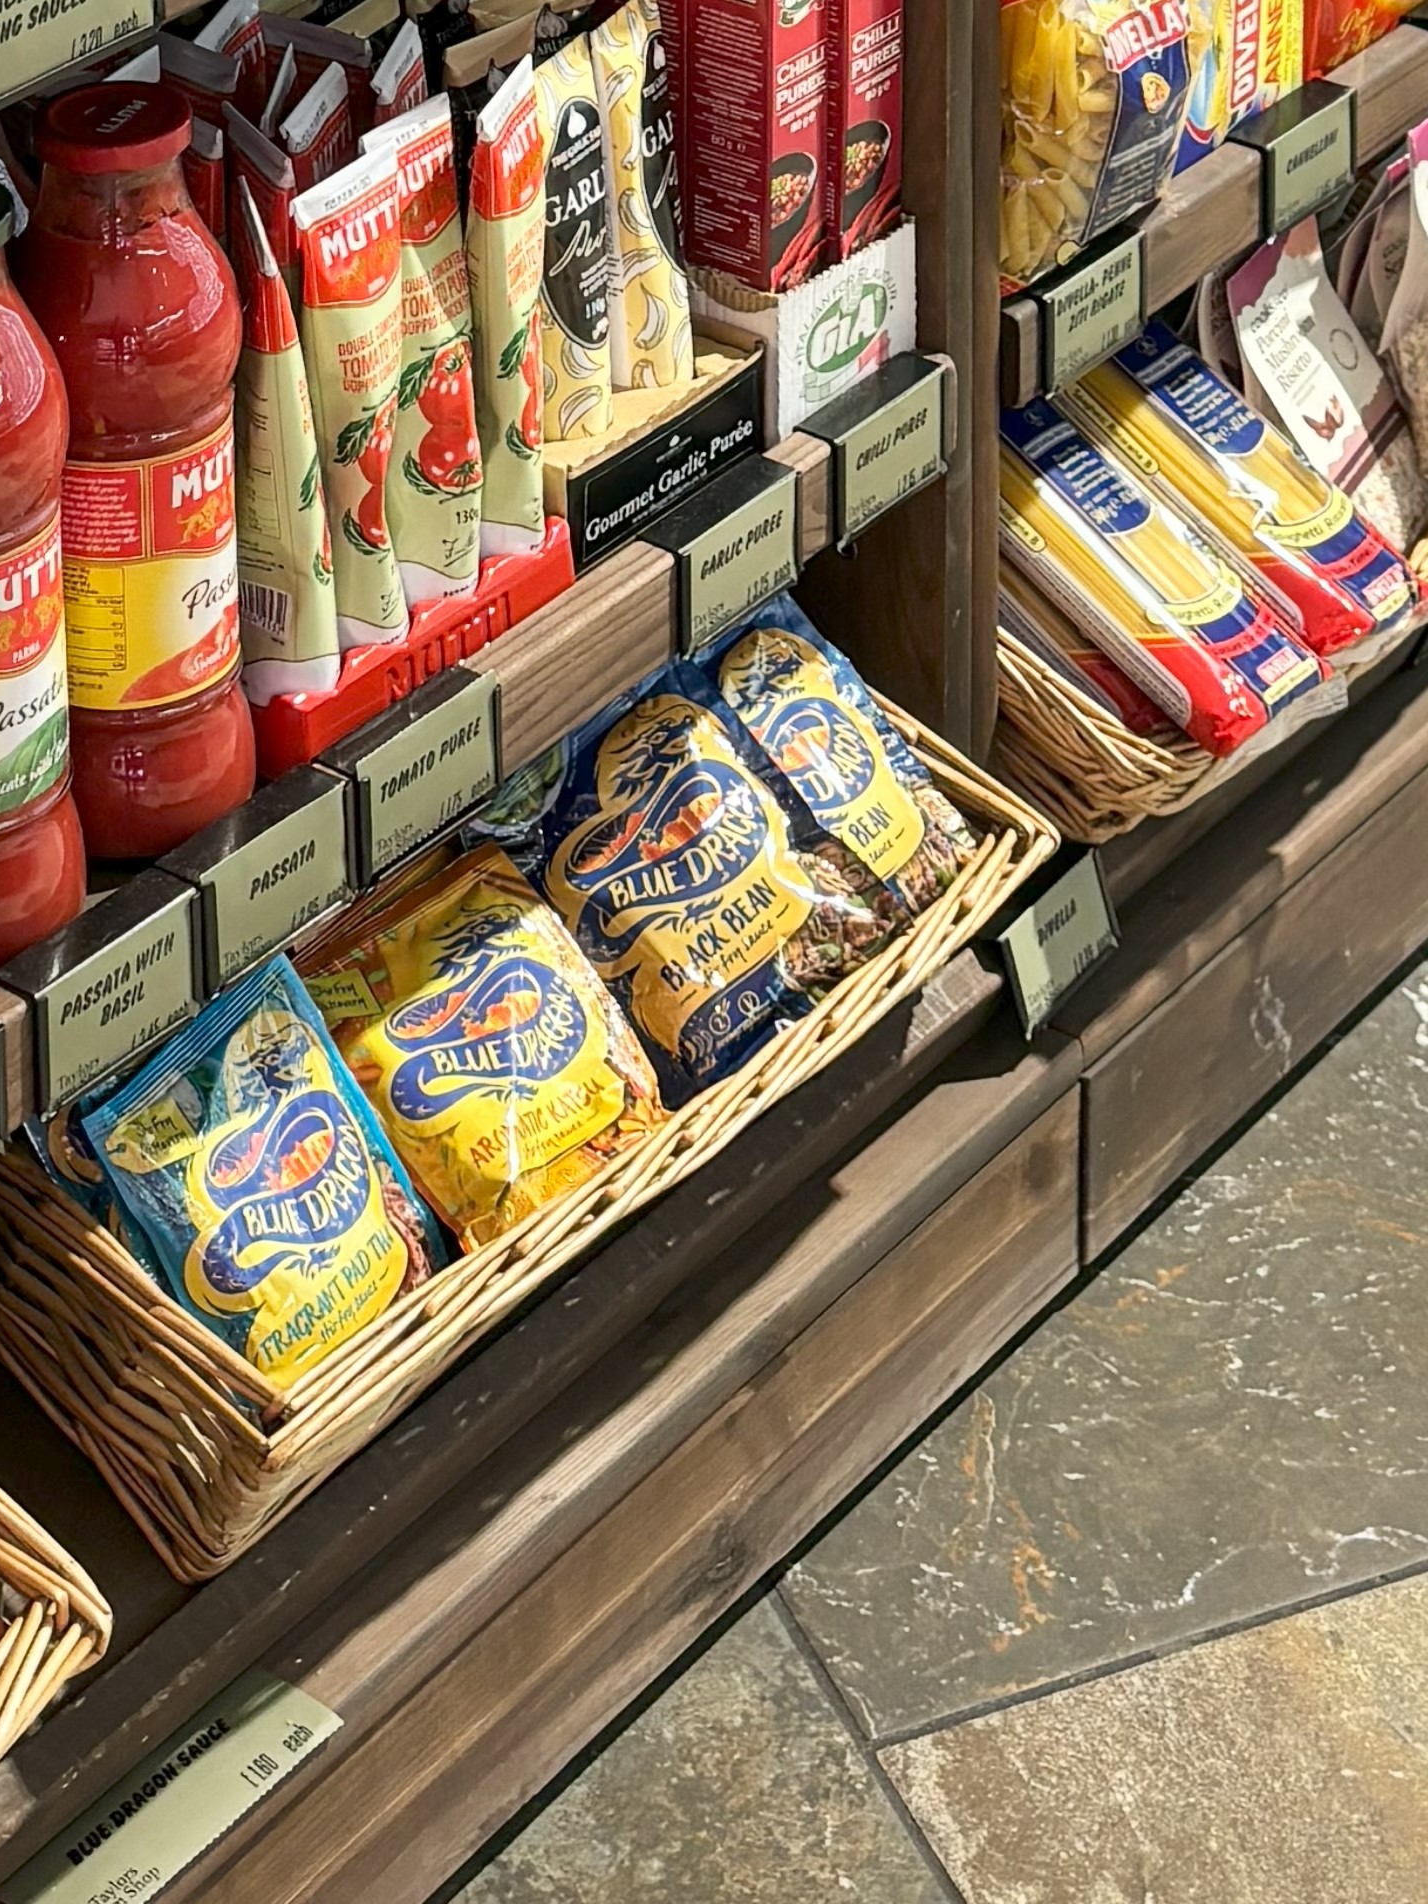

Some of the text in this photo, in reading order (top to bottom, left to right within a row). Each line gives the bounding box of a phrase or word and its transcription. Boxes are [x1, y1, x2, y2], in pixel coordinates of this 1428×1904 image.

[775, 52, 827, 88] CHILLI
[585, 414, 756, 543] Gourmet Garlic Purée
[856, 404, 928, 471] CHILLI PUREE
[700, 509, 782, 583] GARLIC PUREE
[380, 720, 481, 803] TOMATO PUREE
[249, 836, 318, 903] PASSATA
[606, 790, 766, 910] BLUE DRAGON
[60, 930, 177, 1028] PASSATA WITH
[664, 882, 779, 993] BLACK BEAN
[99, 980, 146, 1028] BASIL
[430, 980, 576, 1077] BLUE DRAGON
[242, 1122, 369, 1239] BLUE DRAGON
[260, 1277, 340, 1369] FRAGRANT
[66, 1718, 229, 1869] BLUE DRAGON SAUCE
